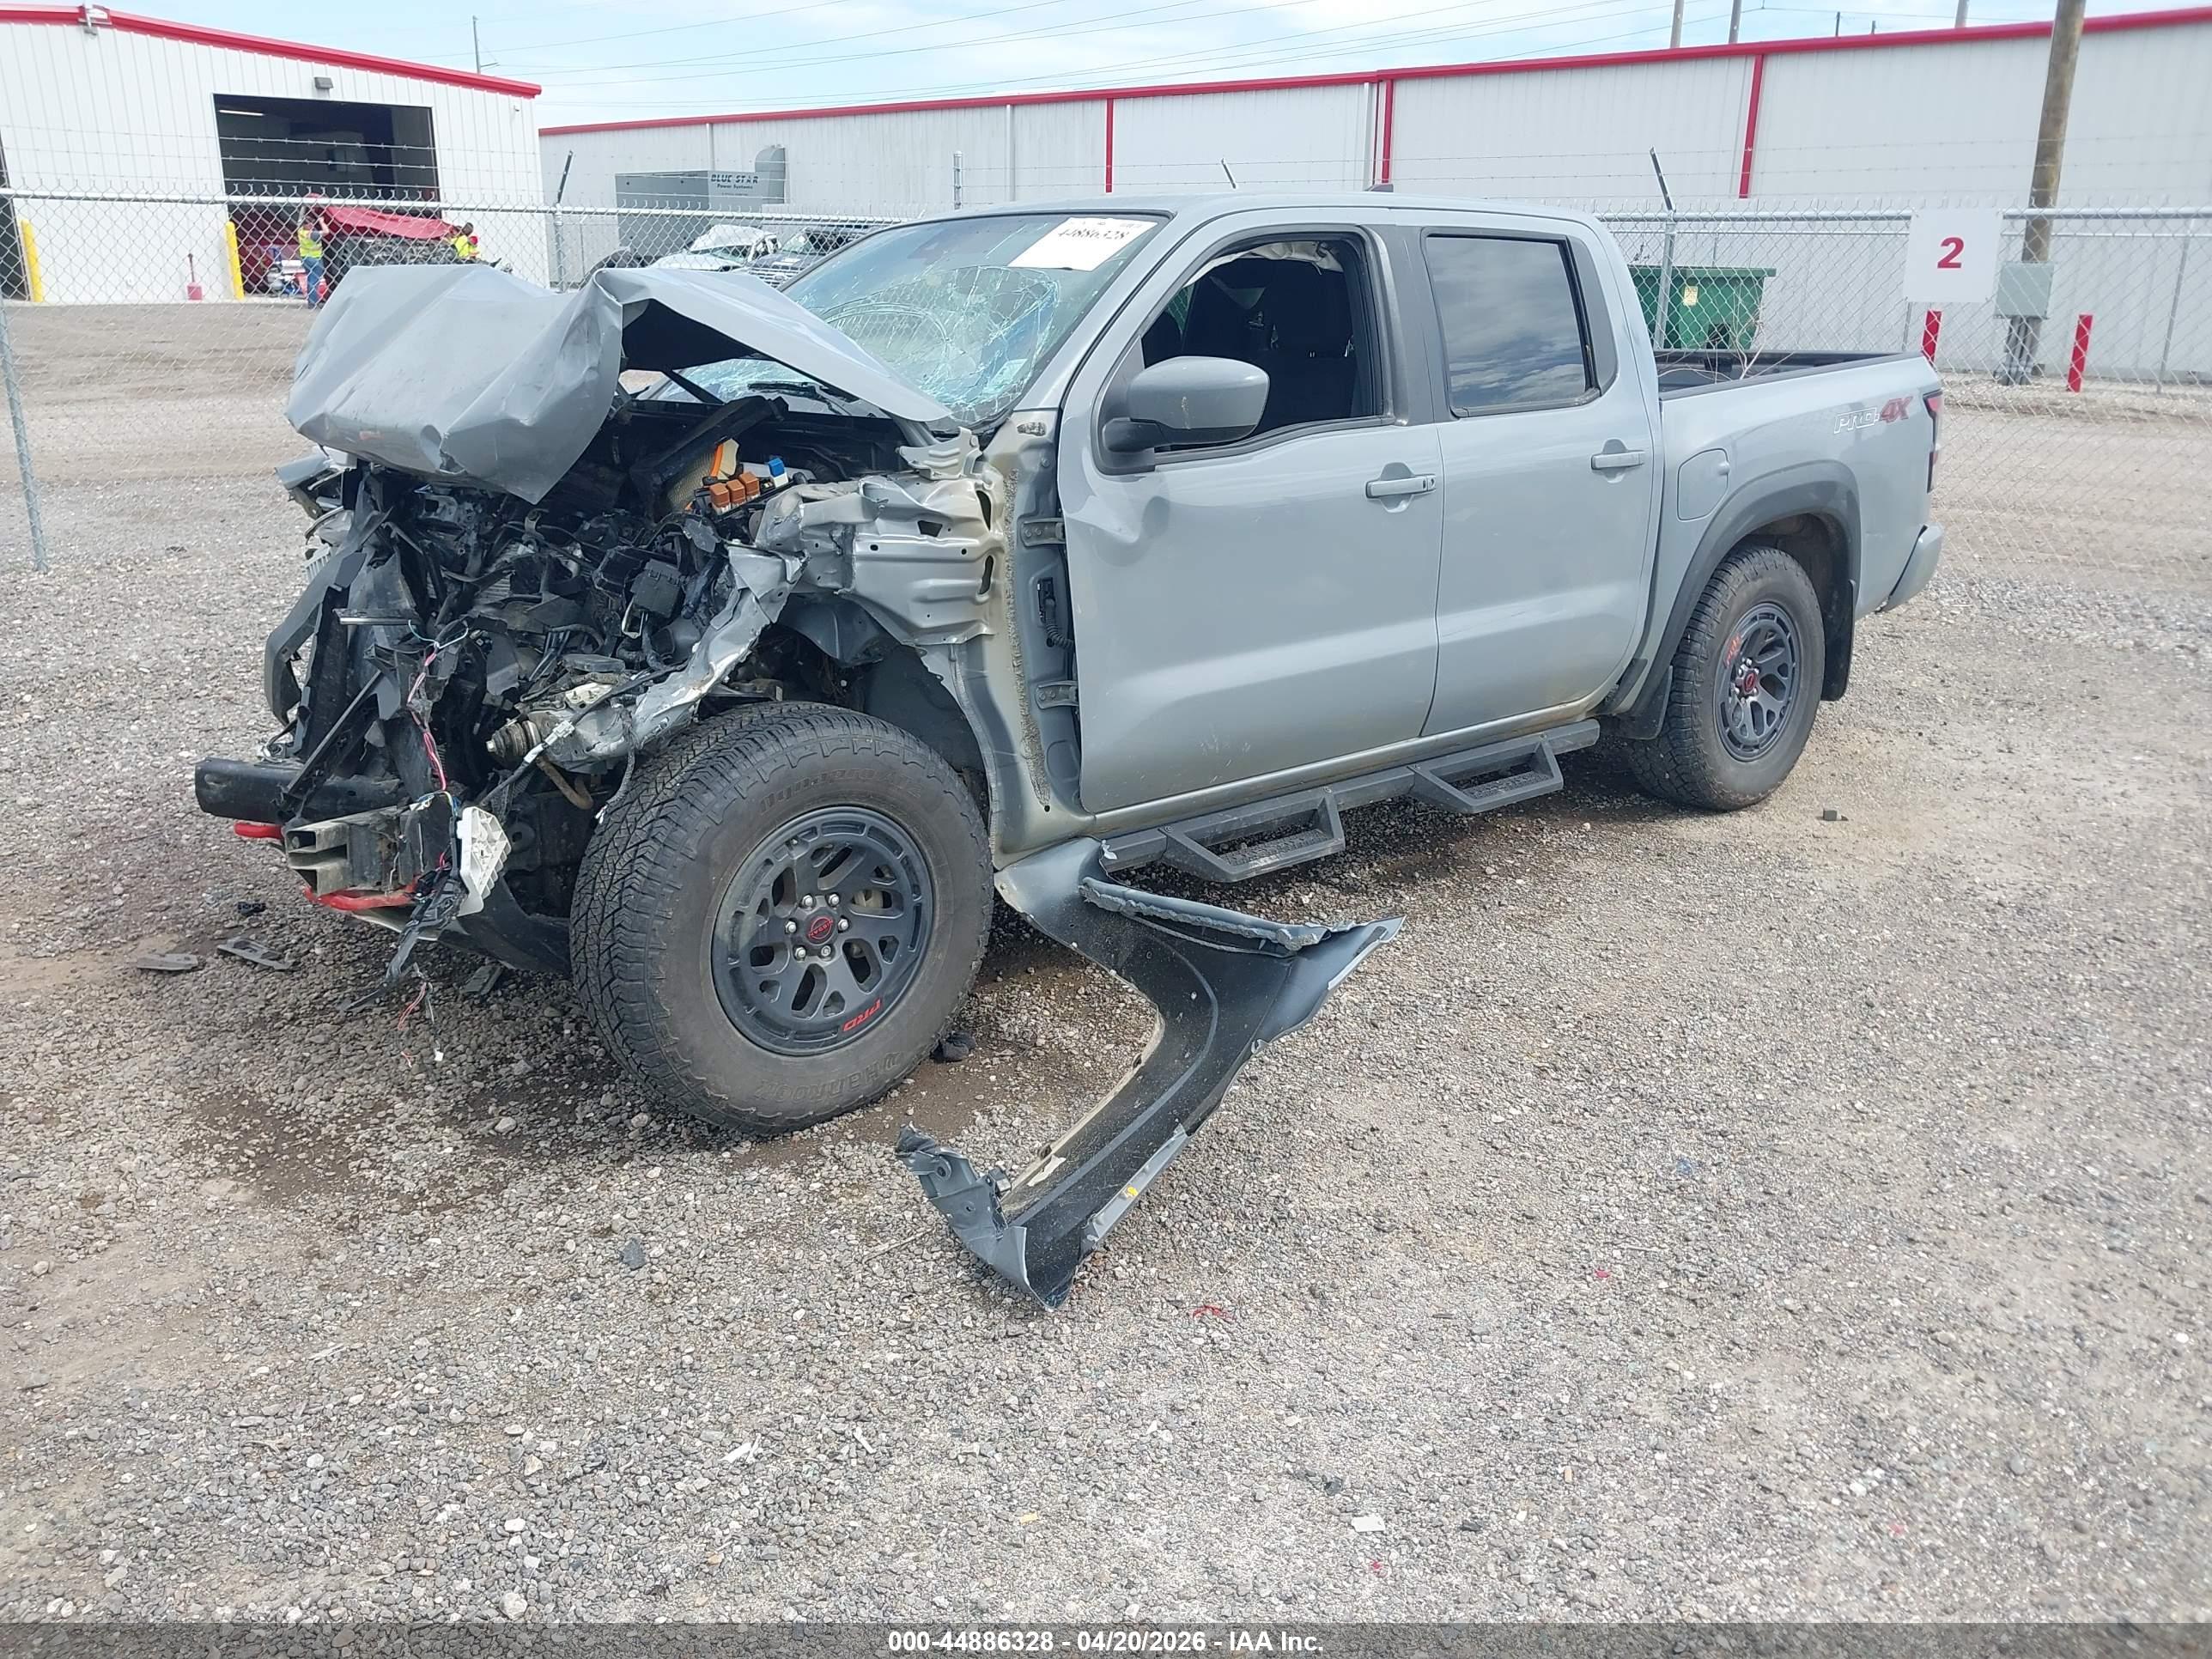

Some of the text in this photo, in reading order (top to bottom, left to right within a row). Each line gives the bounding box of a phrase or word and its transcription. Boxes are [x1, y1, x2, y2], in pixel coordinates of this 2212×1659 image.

[711, 174, 758, 184] BLUE STAR
[1936, 237, 1965, 269] 2
